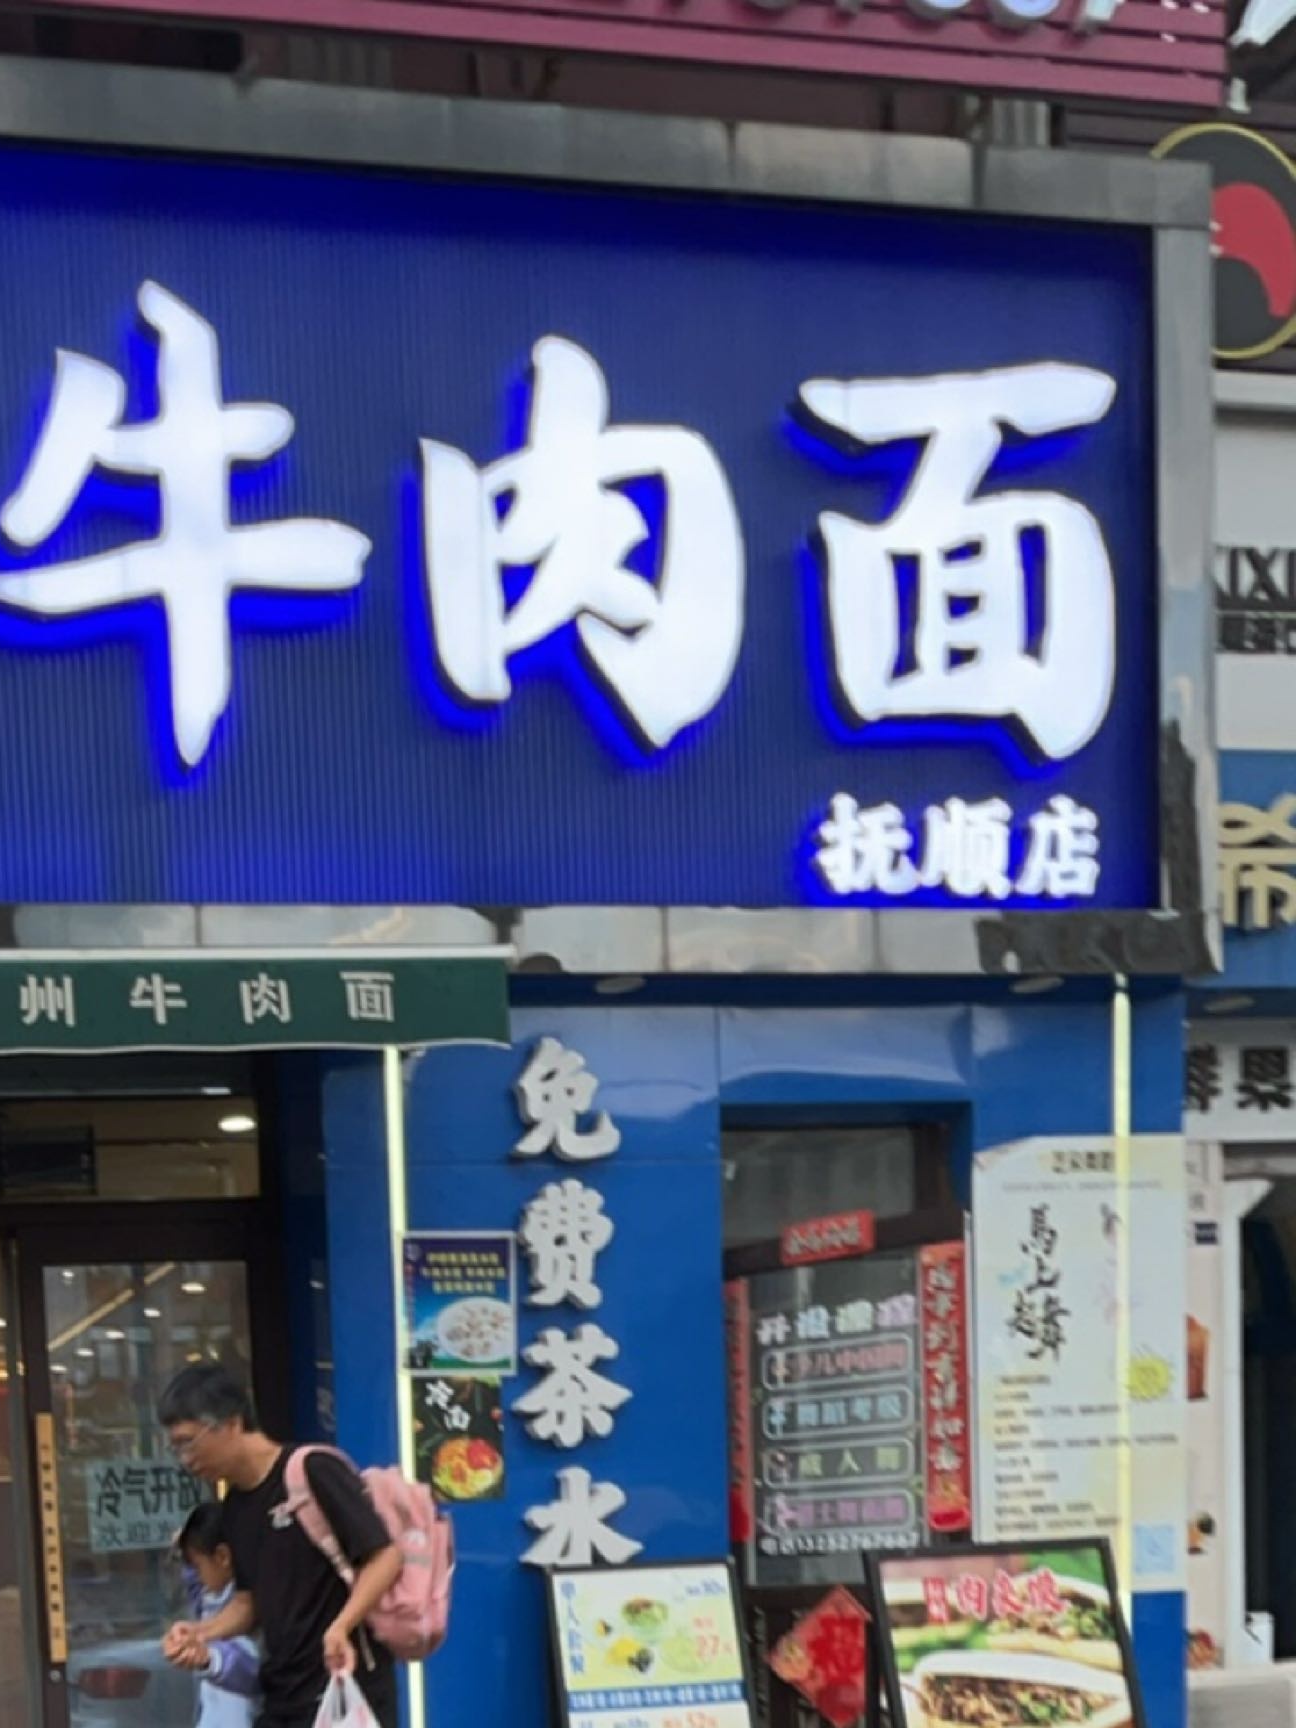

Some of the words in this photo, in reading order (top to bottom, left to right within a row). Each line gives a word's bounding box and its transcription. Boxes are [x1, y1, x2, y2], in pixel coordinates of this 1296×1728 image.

[814, 793, 1101, 899] 抚顺店
[511, 1036, 645, 1568] 免费茶水
[95, 1467, 201, 1518] 冷气开放
